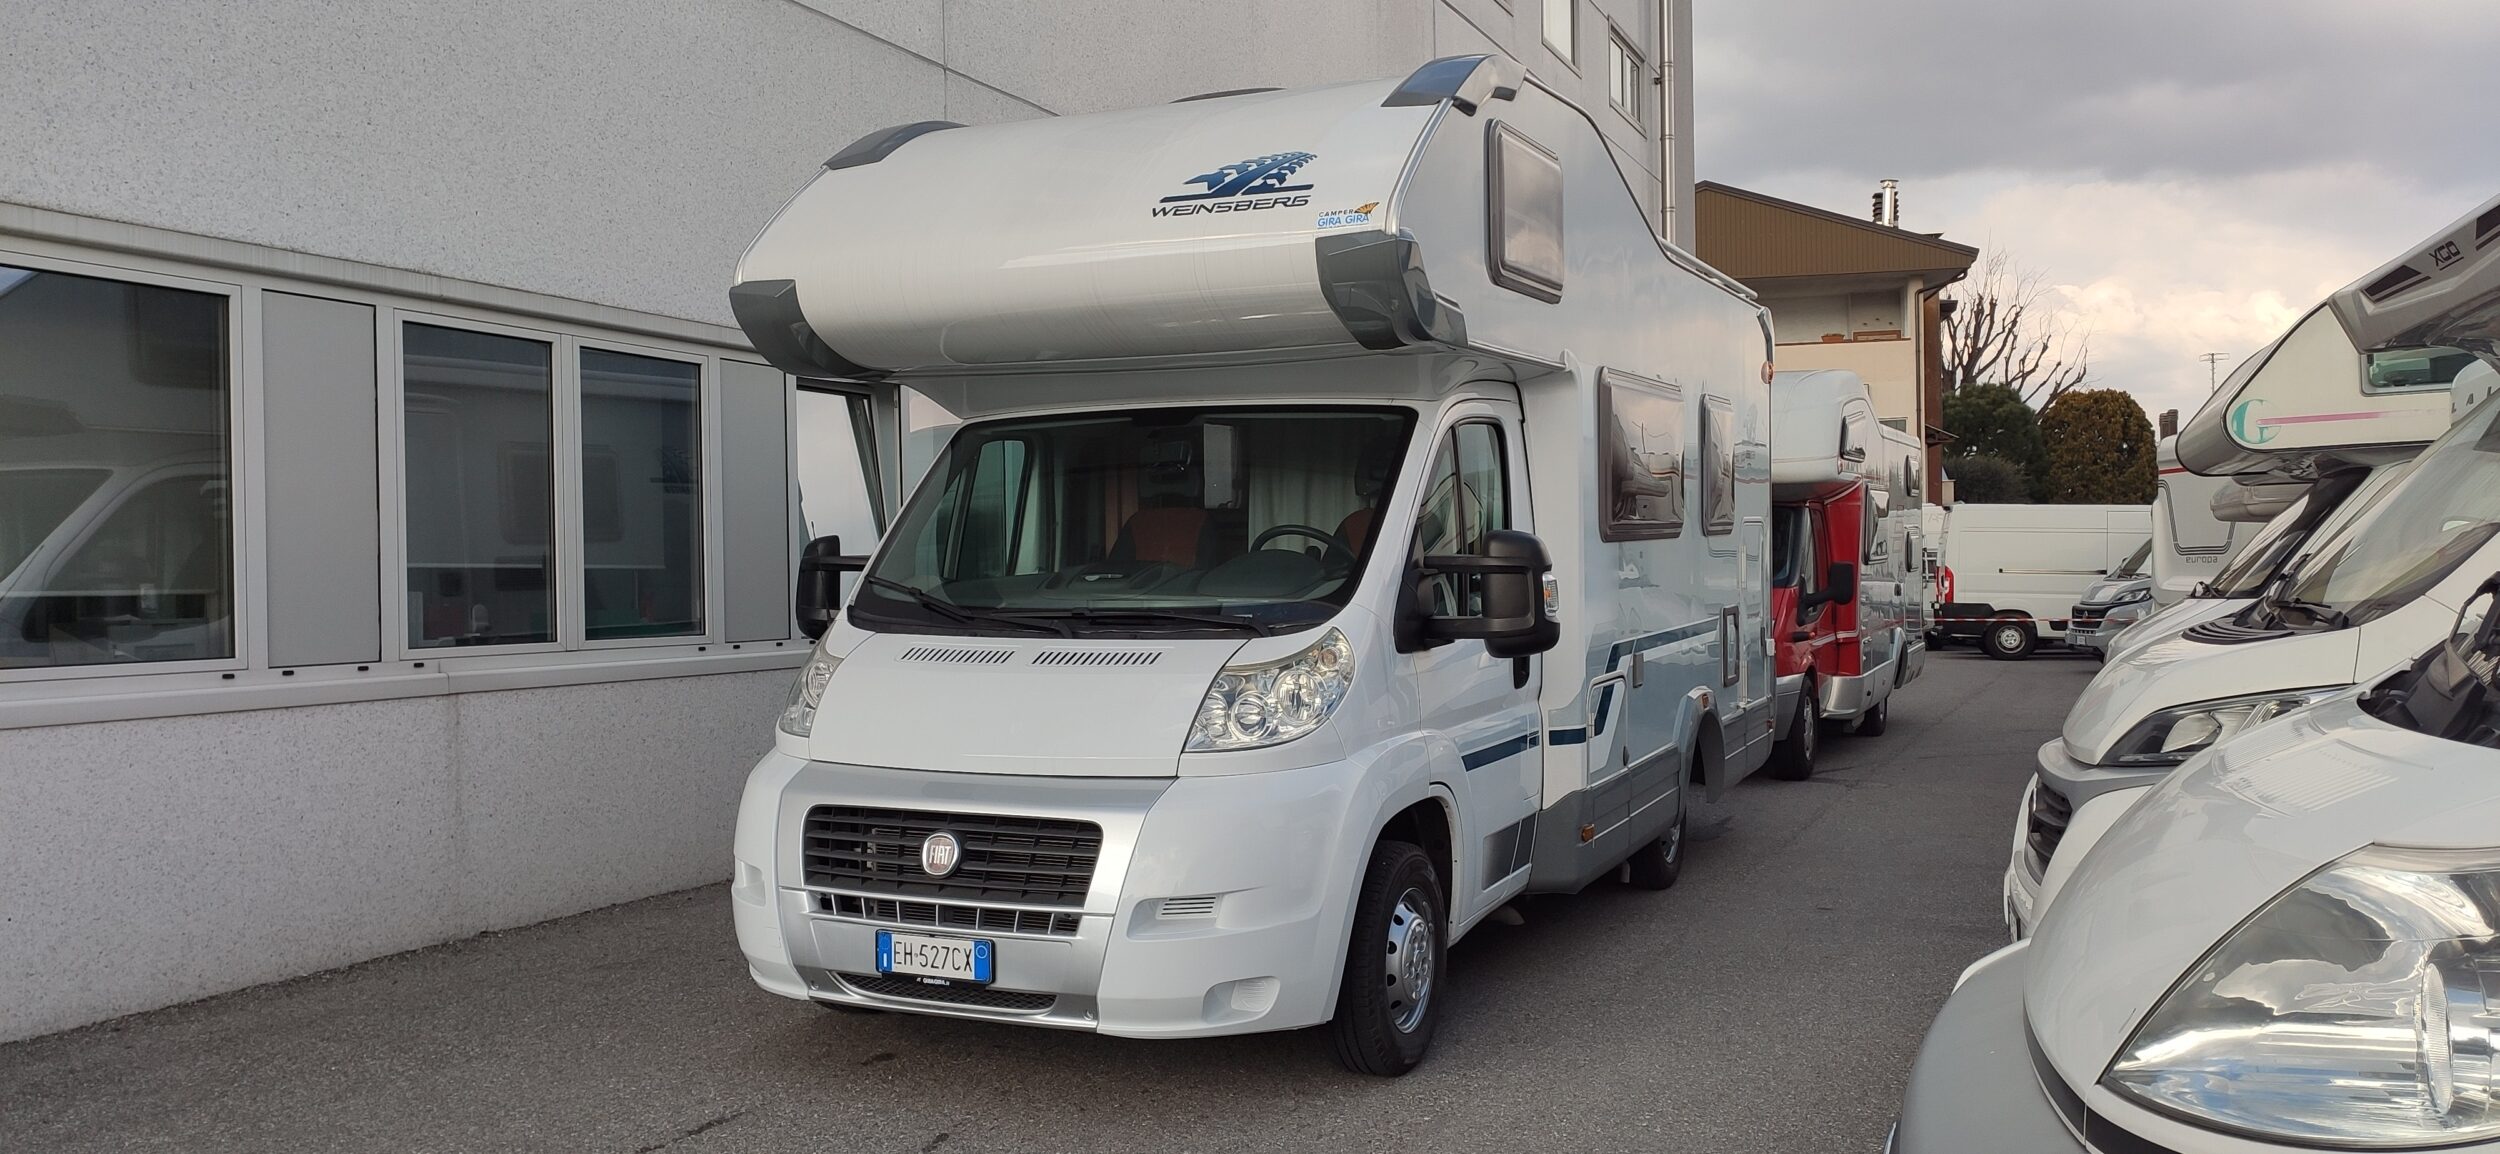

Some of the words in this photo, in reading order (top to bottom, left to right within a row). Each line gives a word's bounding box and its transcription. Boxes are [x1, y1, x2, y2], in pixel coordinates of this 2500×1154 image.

[1152, 195, 1311, 217] WEINSBERG
[1317, 216, 1342, 227] GIRA
[1345, 213, 1370, 224] GIRA
[1318, 209, 1354, 218] CAMPER
[2185, 556, 2218, 564] europa
[929, 845, 952, 865] FIAT
